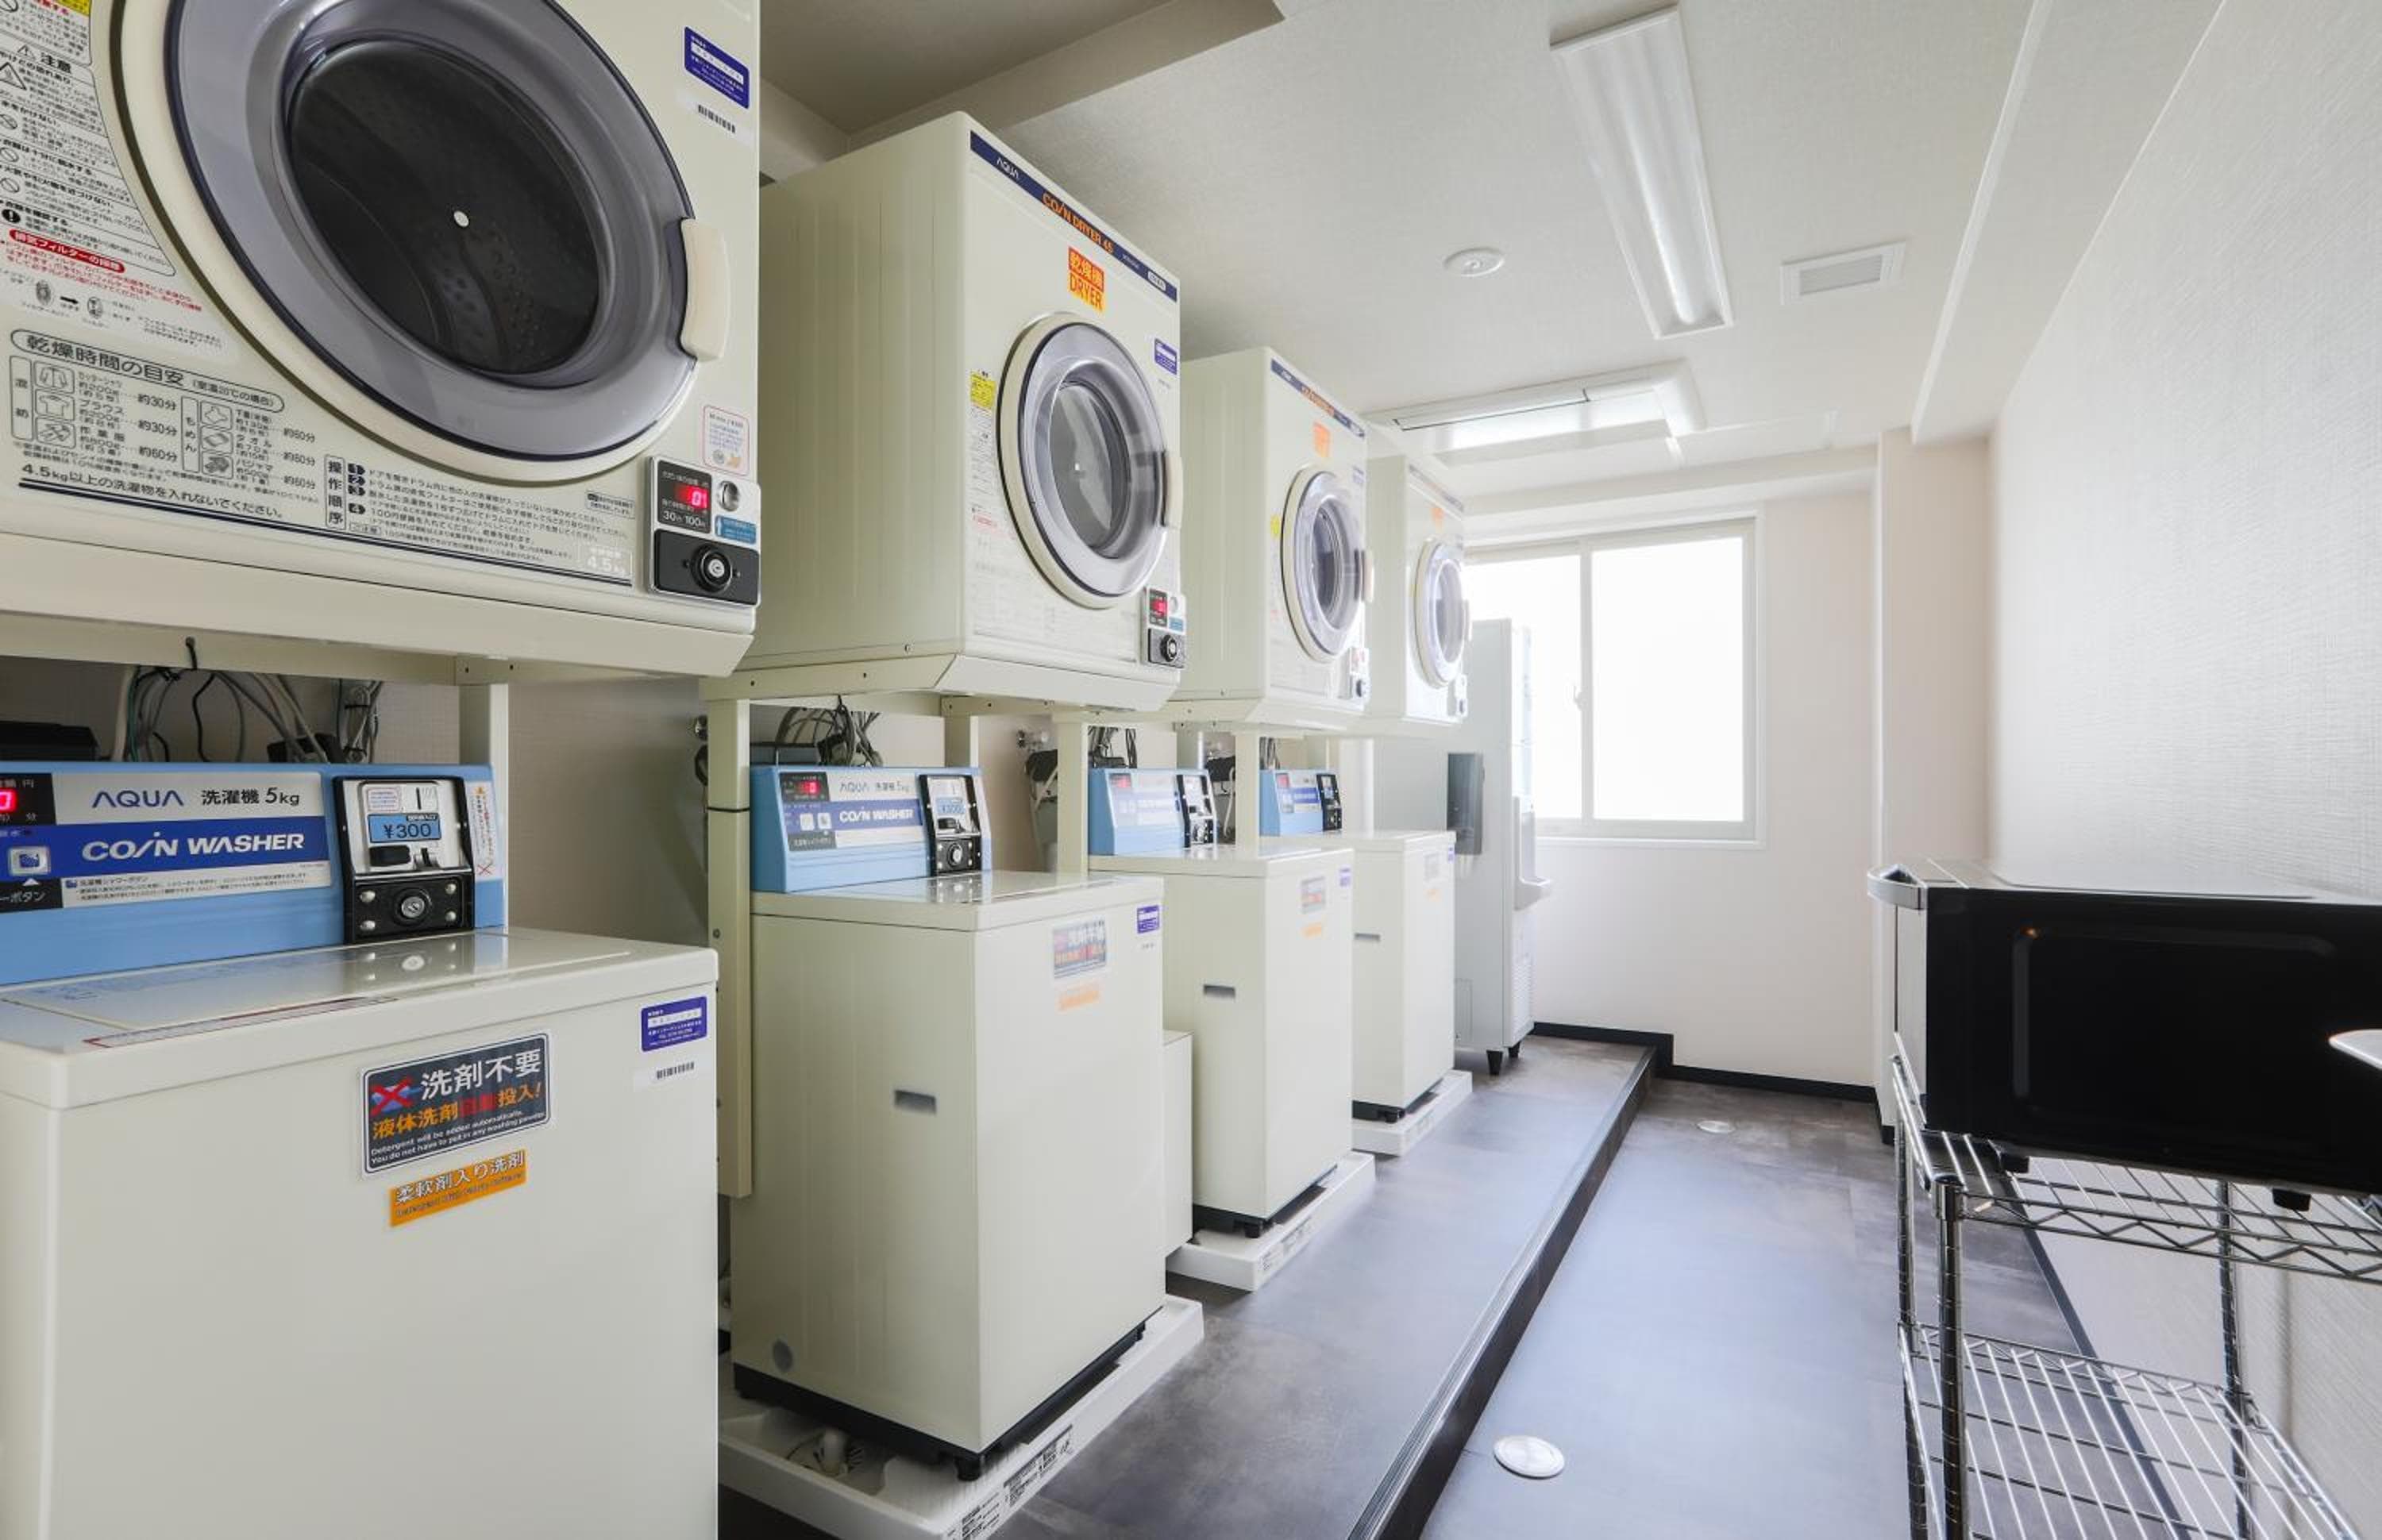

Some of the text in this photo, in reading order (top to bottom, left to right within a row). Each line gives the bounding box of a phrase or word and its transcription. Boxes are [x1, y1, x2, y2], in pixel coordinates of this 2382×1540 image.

[1070, 272, 1103, 310] DRYER
[28, 334, 185, 387] 乾燥時間の目安
[328, 461, 343, 525] 操作順序
[92, 787, 300, 808] AQUA 洗濯機 5kg
[873, 808, 913, 820] WASHER
[384, 823, 432, 839] ¥300
[187, 833, 306, 856] WASHER
[421, 1049, 542, 1101] 洗剤不要
[371, 1138, 414, 1157] Detergent
[371, 1154, 388, 1165] You
[397, 1151, 524, 1205] 柔軟剤入り洗剤
